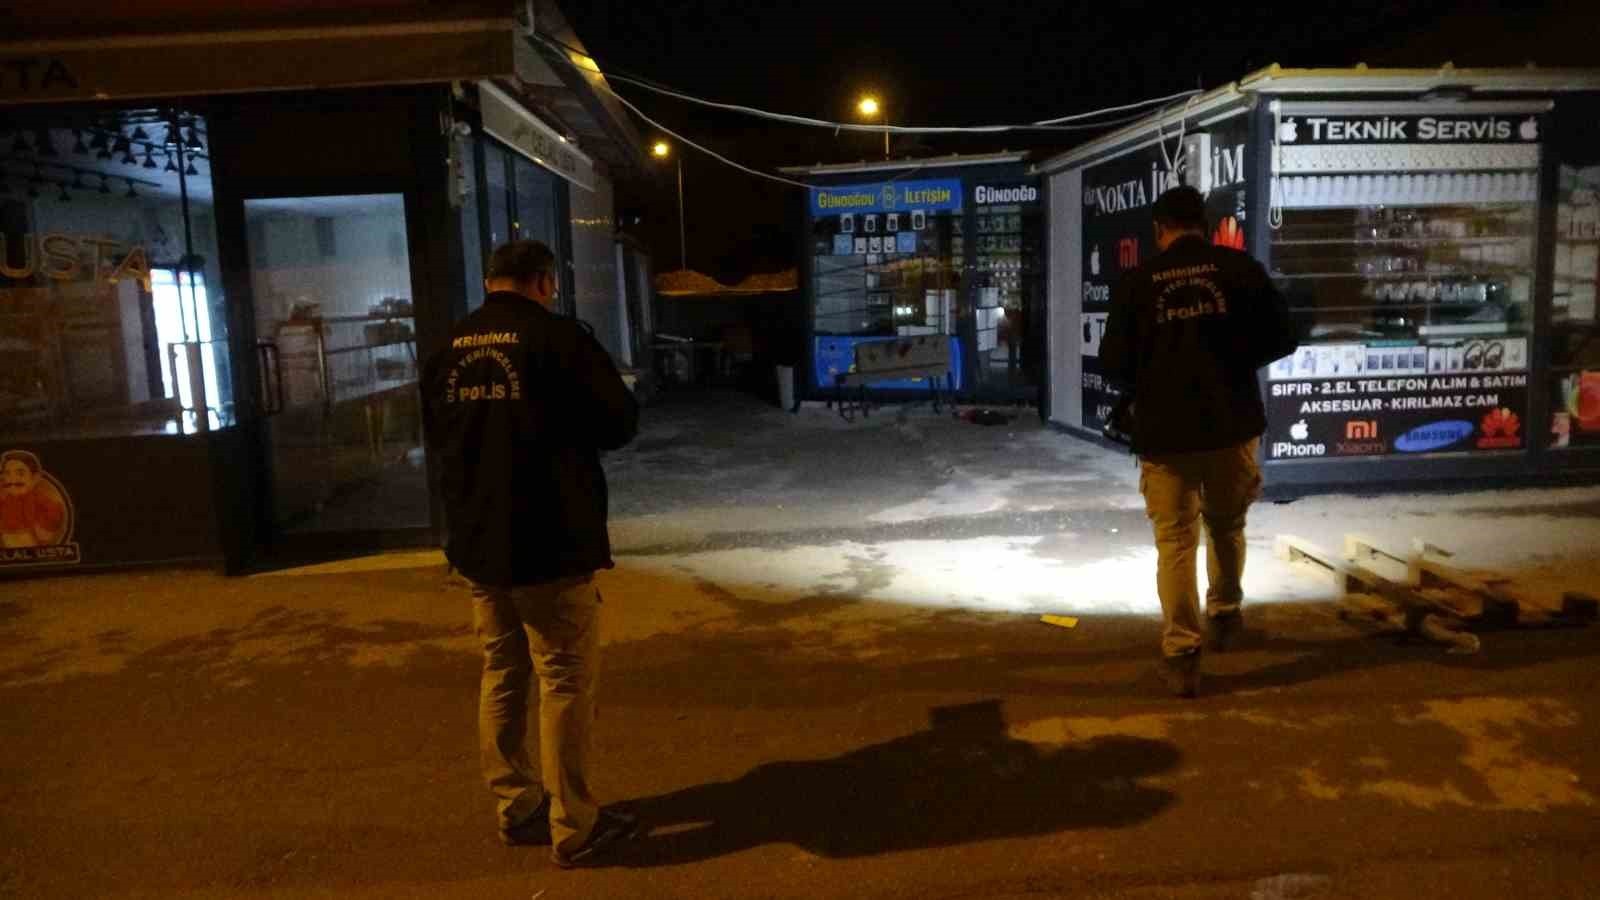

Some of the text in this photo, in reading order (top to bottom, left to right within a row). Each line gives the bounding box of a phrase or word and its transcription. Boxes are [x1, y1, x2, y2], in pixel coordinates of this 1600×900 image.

[1307, 117, 1511, 140] TEKNİK SERVİS
[1272, 382, 1313, 396] SIFIR
[1321, 380, 1356, 395] 2.EL
[1359, 379, 1428, 393] TELEFON
[1431, 377, 1467, 389] ALIM
[1483, 375, 1527, 388] SATIM
[1301, 398, 1382, 413] AKSESUAR
[1392, 396, 1463, 410] KIRILMAZ
[1466, 394, 1499, 407] CAM
[1272, 442, 1325, 457] iPhone
